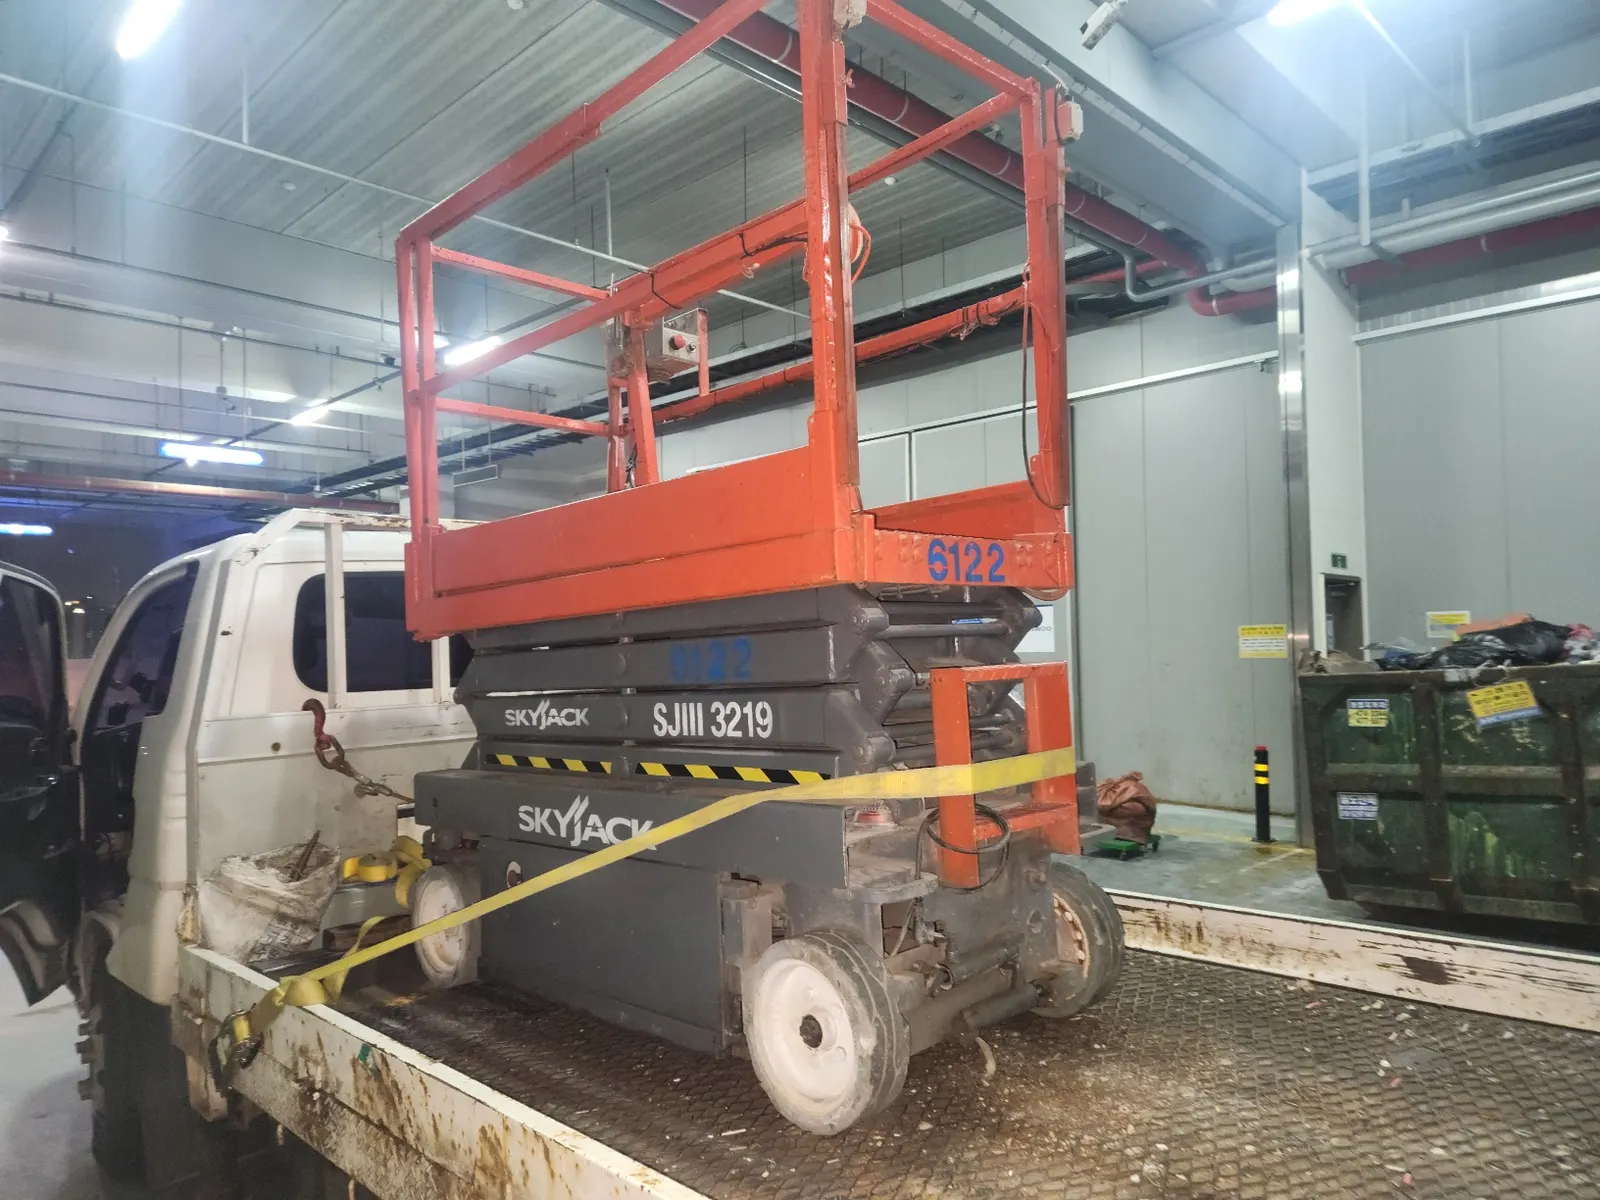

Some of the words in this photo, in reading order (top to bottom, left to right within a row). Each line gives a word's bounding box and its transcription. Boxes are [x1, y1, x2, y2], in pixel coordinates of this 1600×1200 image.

[927, 538, 1005, 582] 6122
[504, 699, 589, 730] SKYJACK
[653, 702, 704, 737] SJIII
[710, 701, 773, 738] 3219
